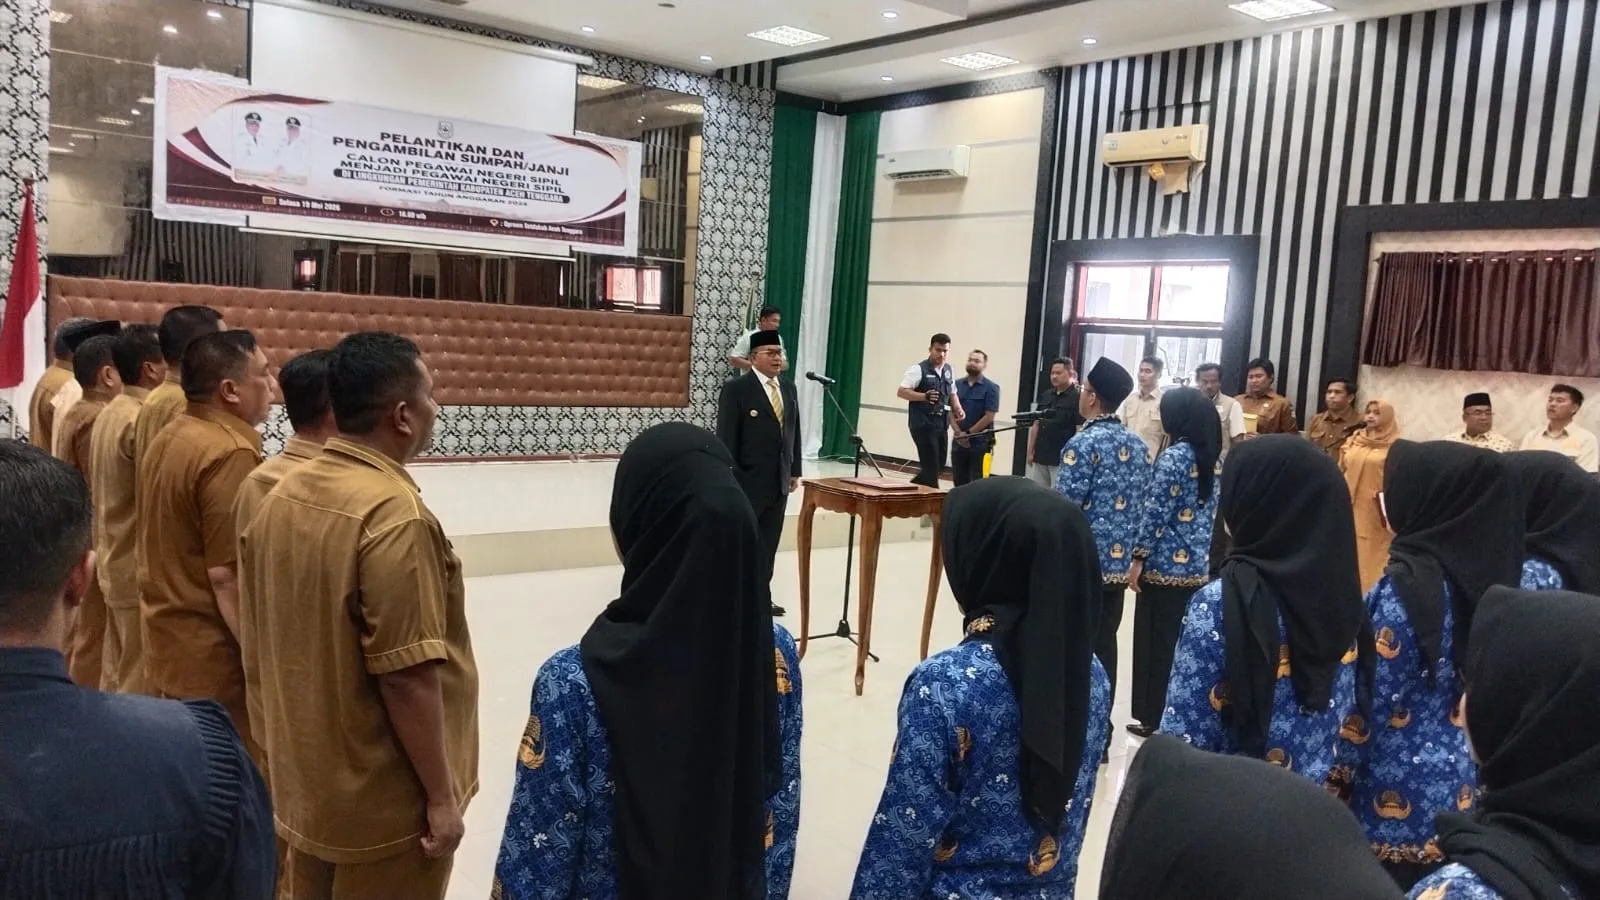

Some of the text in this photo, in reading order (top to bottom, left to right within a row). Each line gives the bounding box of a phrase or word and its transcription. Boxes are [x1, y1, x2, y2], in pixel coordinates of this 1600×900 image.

[332, 136, 569, 176] PENGAMBILAN SUMPAH/JANJI
[380, 132, 524, 160] PELANTIKAN DAN
[340, 160, 564, 194] MENJADI PEGAWAI NEGERI SIPIL
[346, 153, 561, 186] CALON PEGAWAI NEGERI SIPIL
